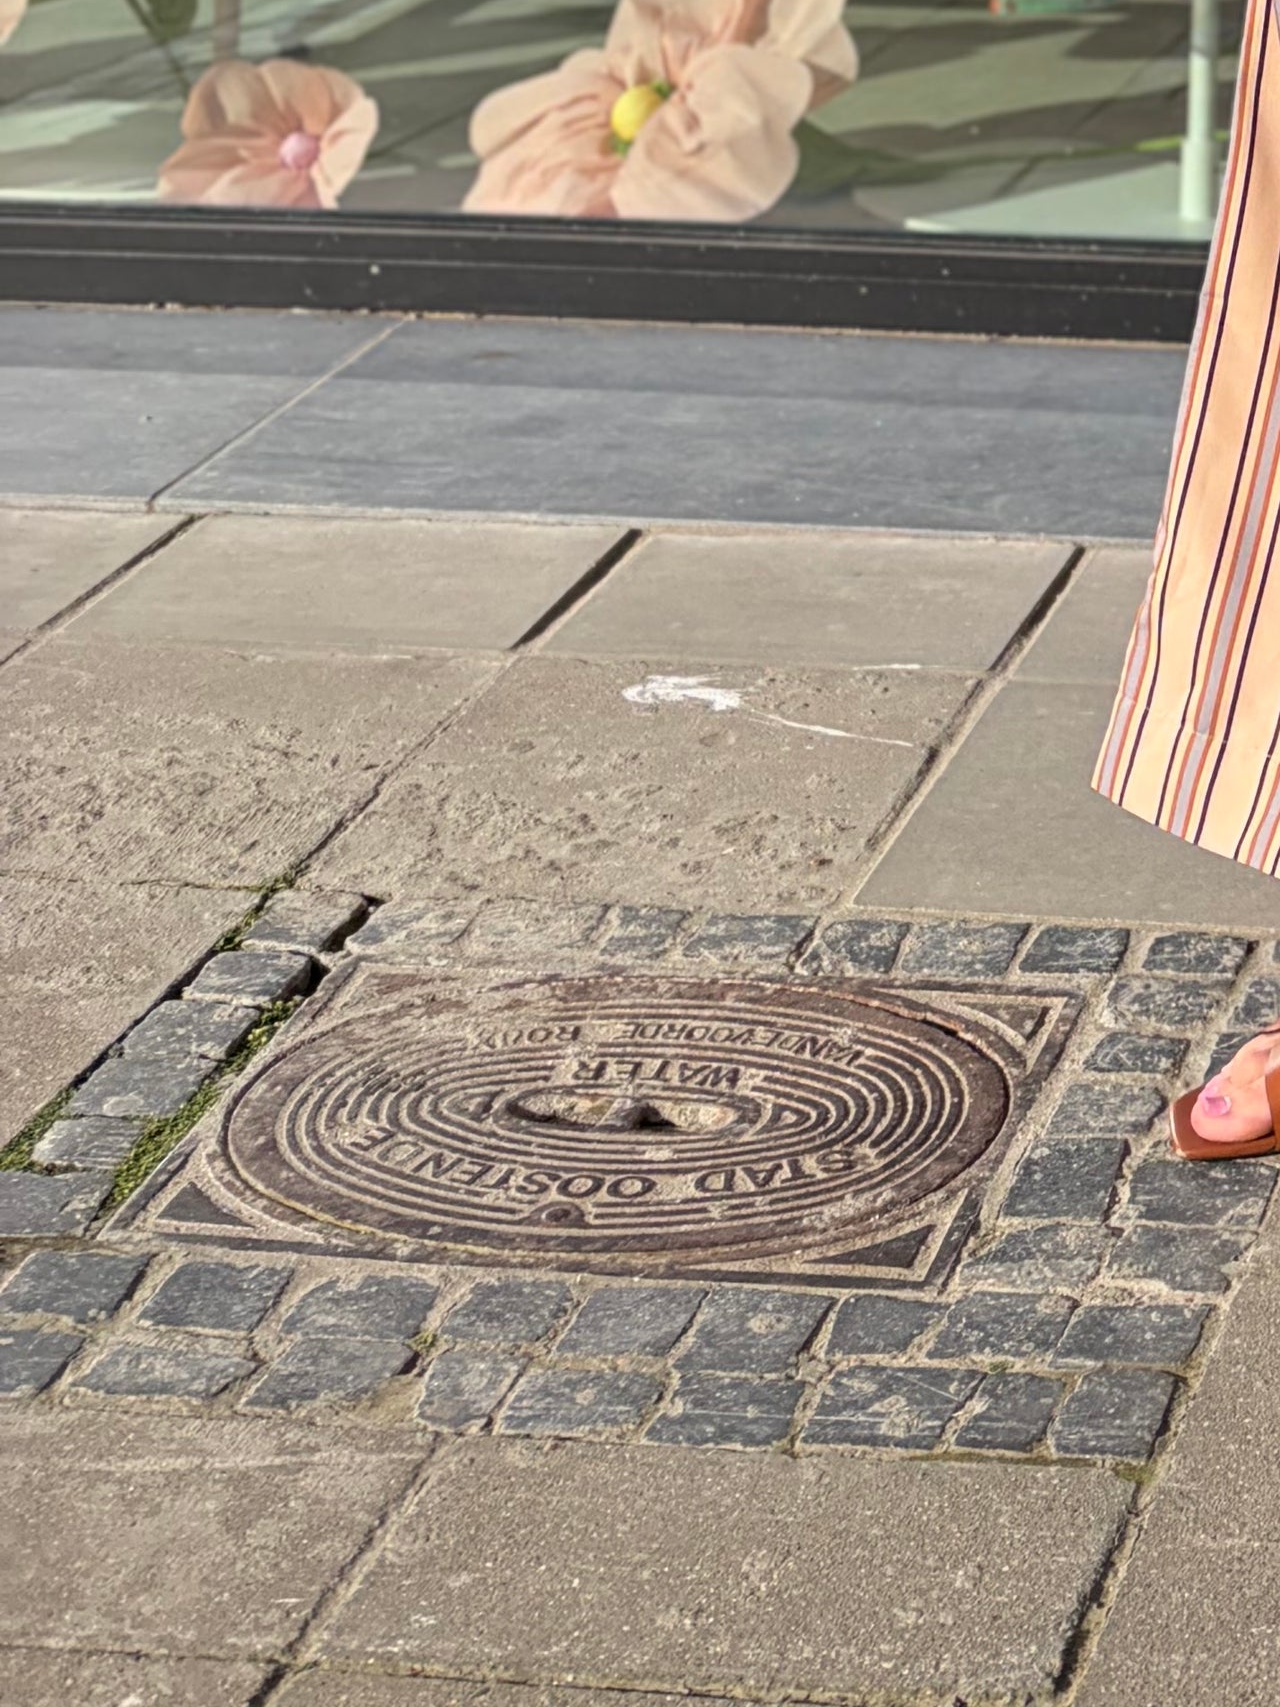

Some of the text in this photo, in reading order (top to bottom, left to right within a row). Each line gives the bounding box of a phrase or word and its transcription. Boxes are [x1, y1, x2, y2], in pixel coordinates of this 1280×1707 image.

[570, 1059, 742, 1090] WATER
[349, 1127, 856, 1198] STAD OOSTENDE
